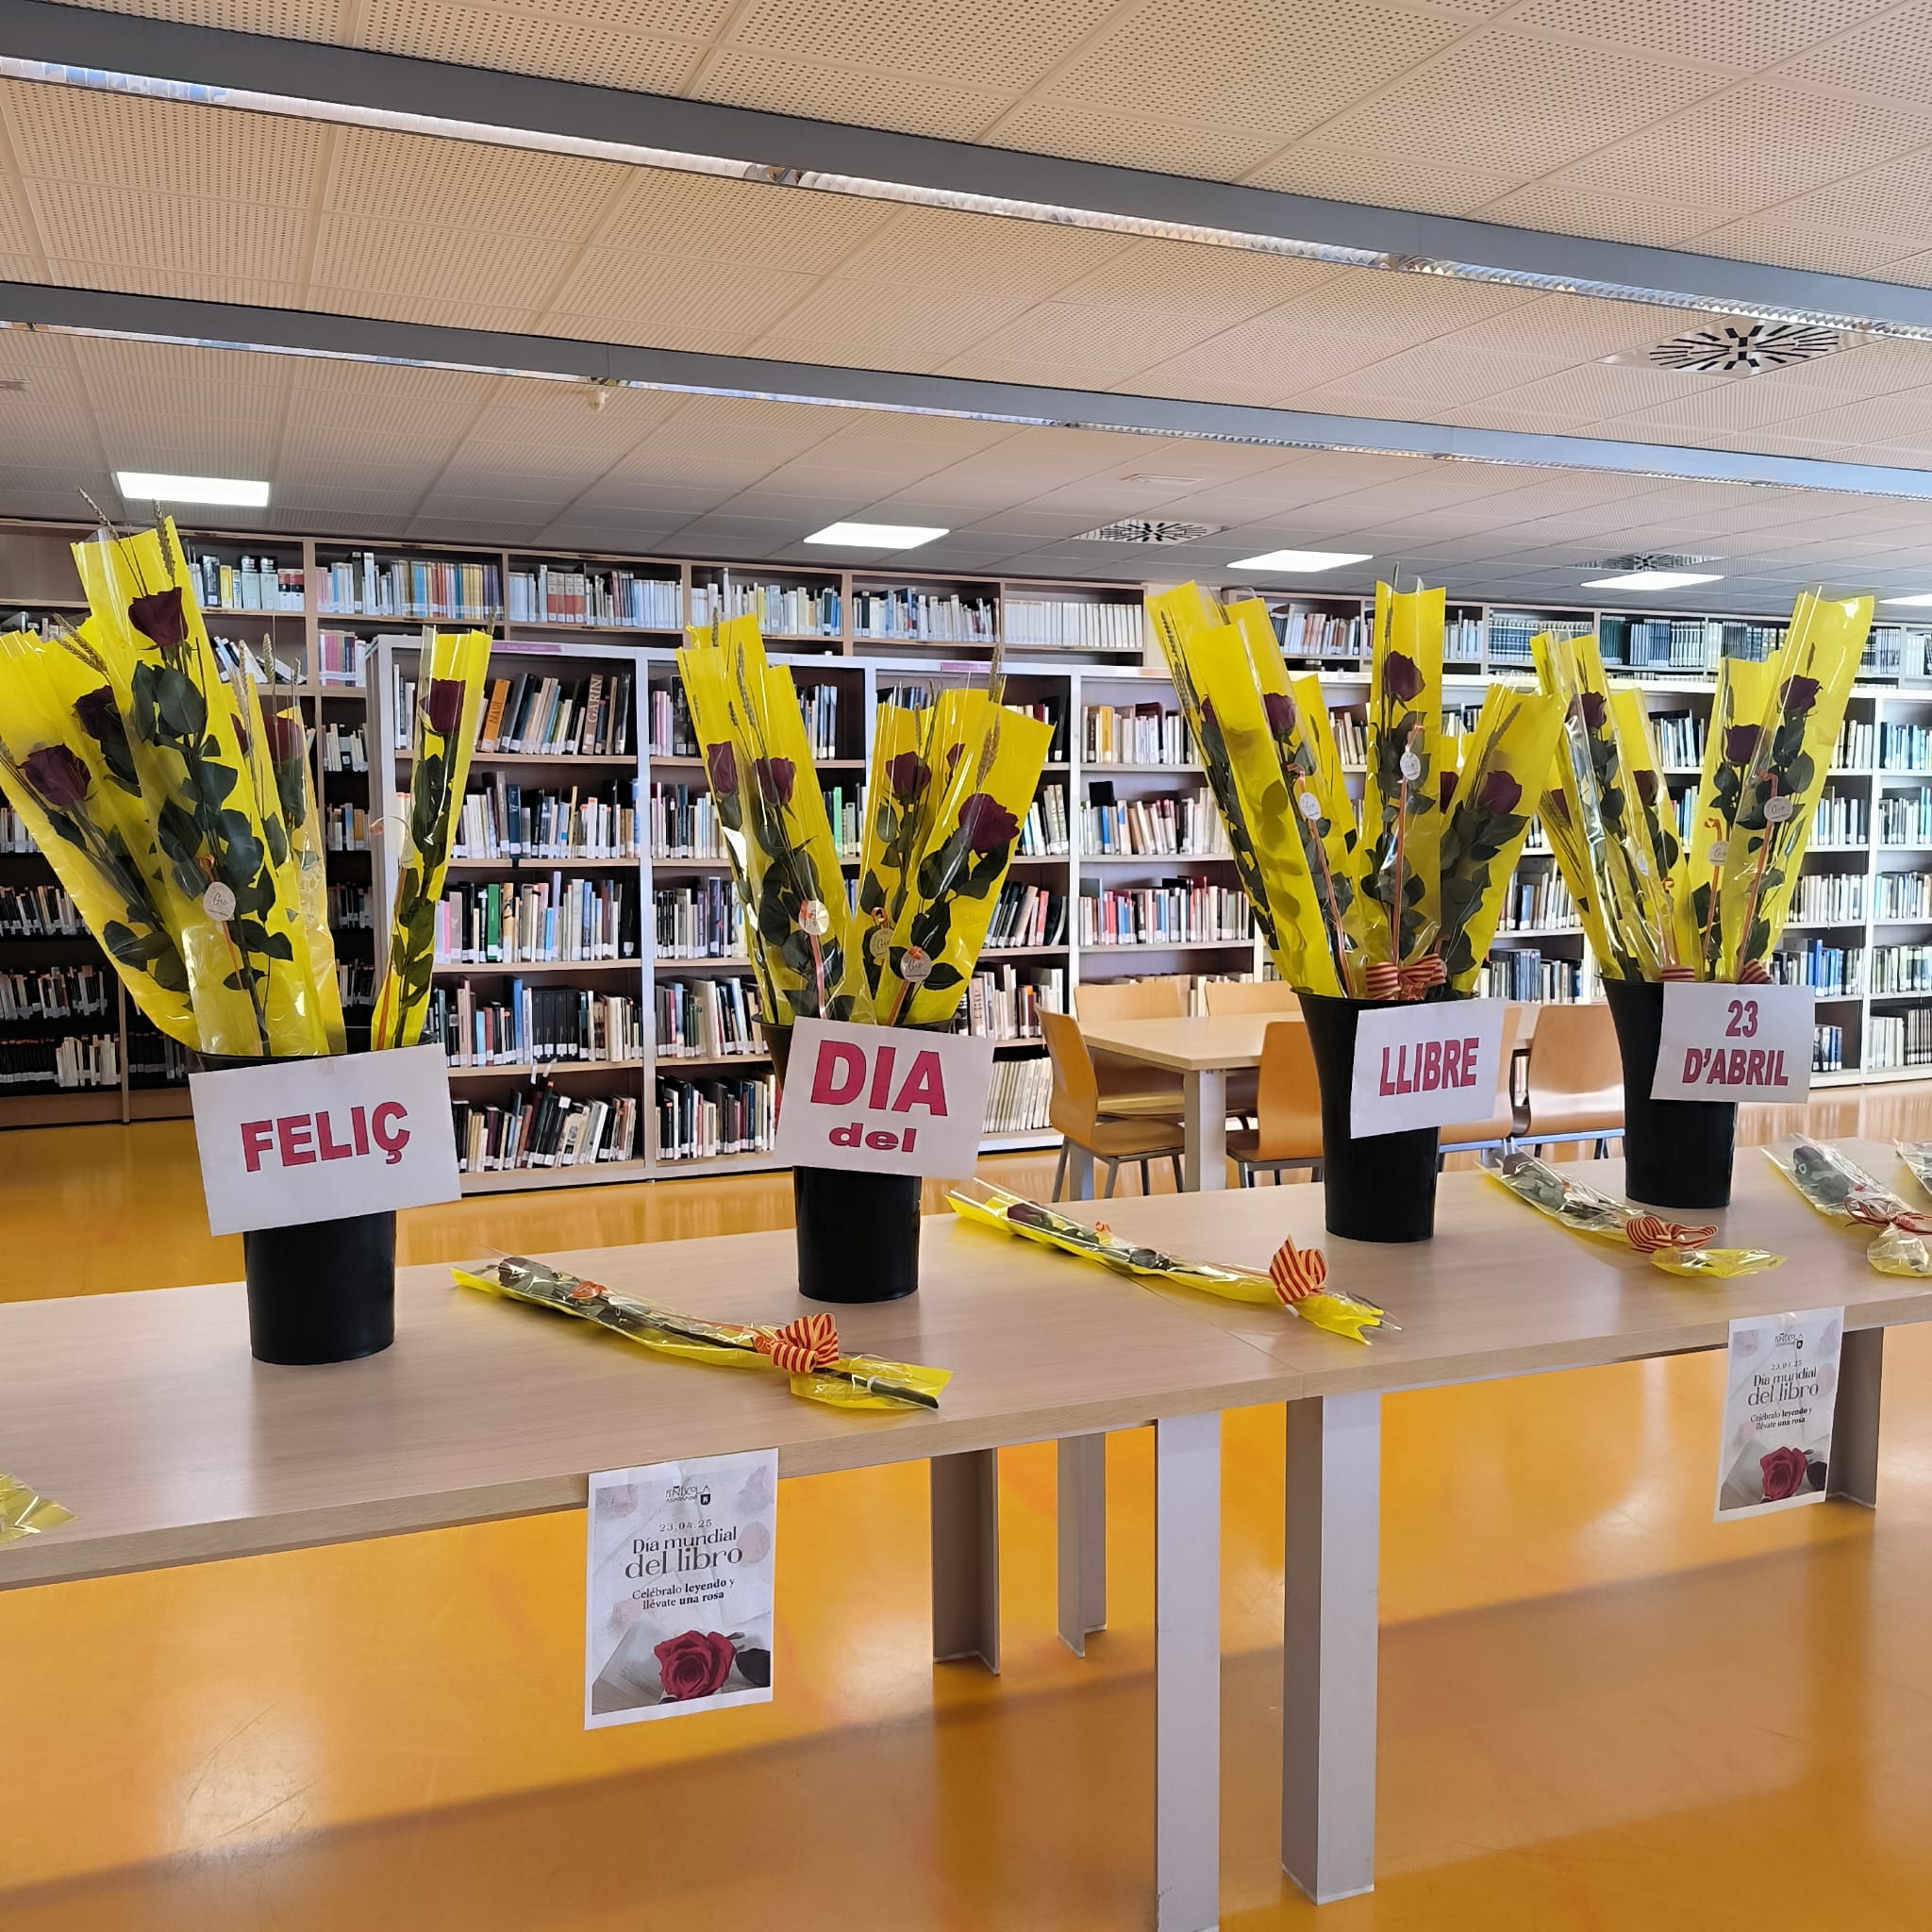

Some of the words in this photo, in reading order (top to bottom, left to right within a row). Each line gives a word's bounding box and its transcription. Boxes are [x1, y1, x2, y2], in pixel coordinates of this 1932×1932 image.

[588, 677, 603, 724] GARIN
[1724, 999, 1758, 1038] 23
[810, 1040, 948, 1117] DIA
[1379, 1037, 1480, 1097] LLIBRE
[1682, 1048, 1790, 1087] D'ABRIL
[241, 1101, 410, 1173] FELIÇ
[828, 1122, 918, 1153] del
[1773, 1366, 1817, 1384] mundial
[1747, 1384, 1774, 1406] del
[1779, 1381, 1819, 1401] libro
[1781, 1407, 1808, 1419] leyendo
[633, 1537, 659, 1554] Día
[664, 1525, 737, 1549] mundial
[659, 1519, 712, 1532] 23.04.25
[625, 1550, 667, 1578] del
[677, 1547, 742, 1572] libro
[632, 1585, 682, 1600] Celébralo
[685, 1578, 726, 1593] leyendo
[729, 1578, 735, 1589] y
[642, 1599, 676, 1610] llévate
[679, 1594, 699, 1605] una
[702, 1591, 724, 1602] rosa
